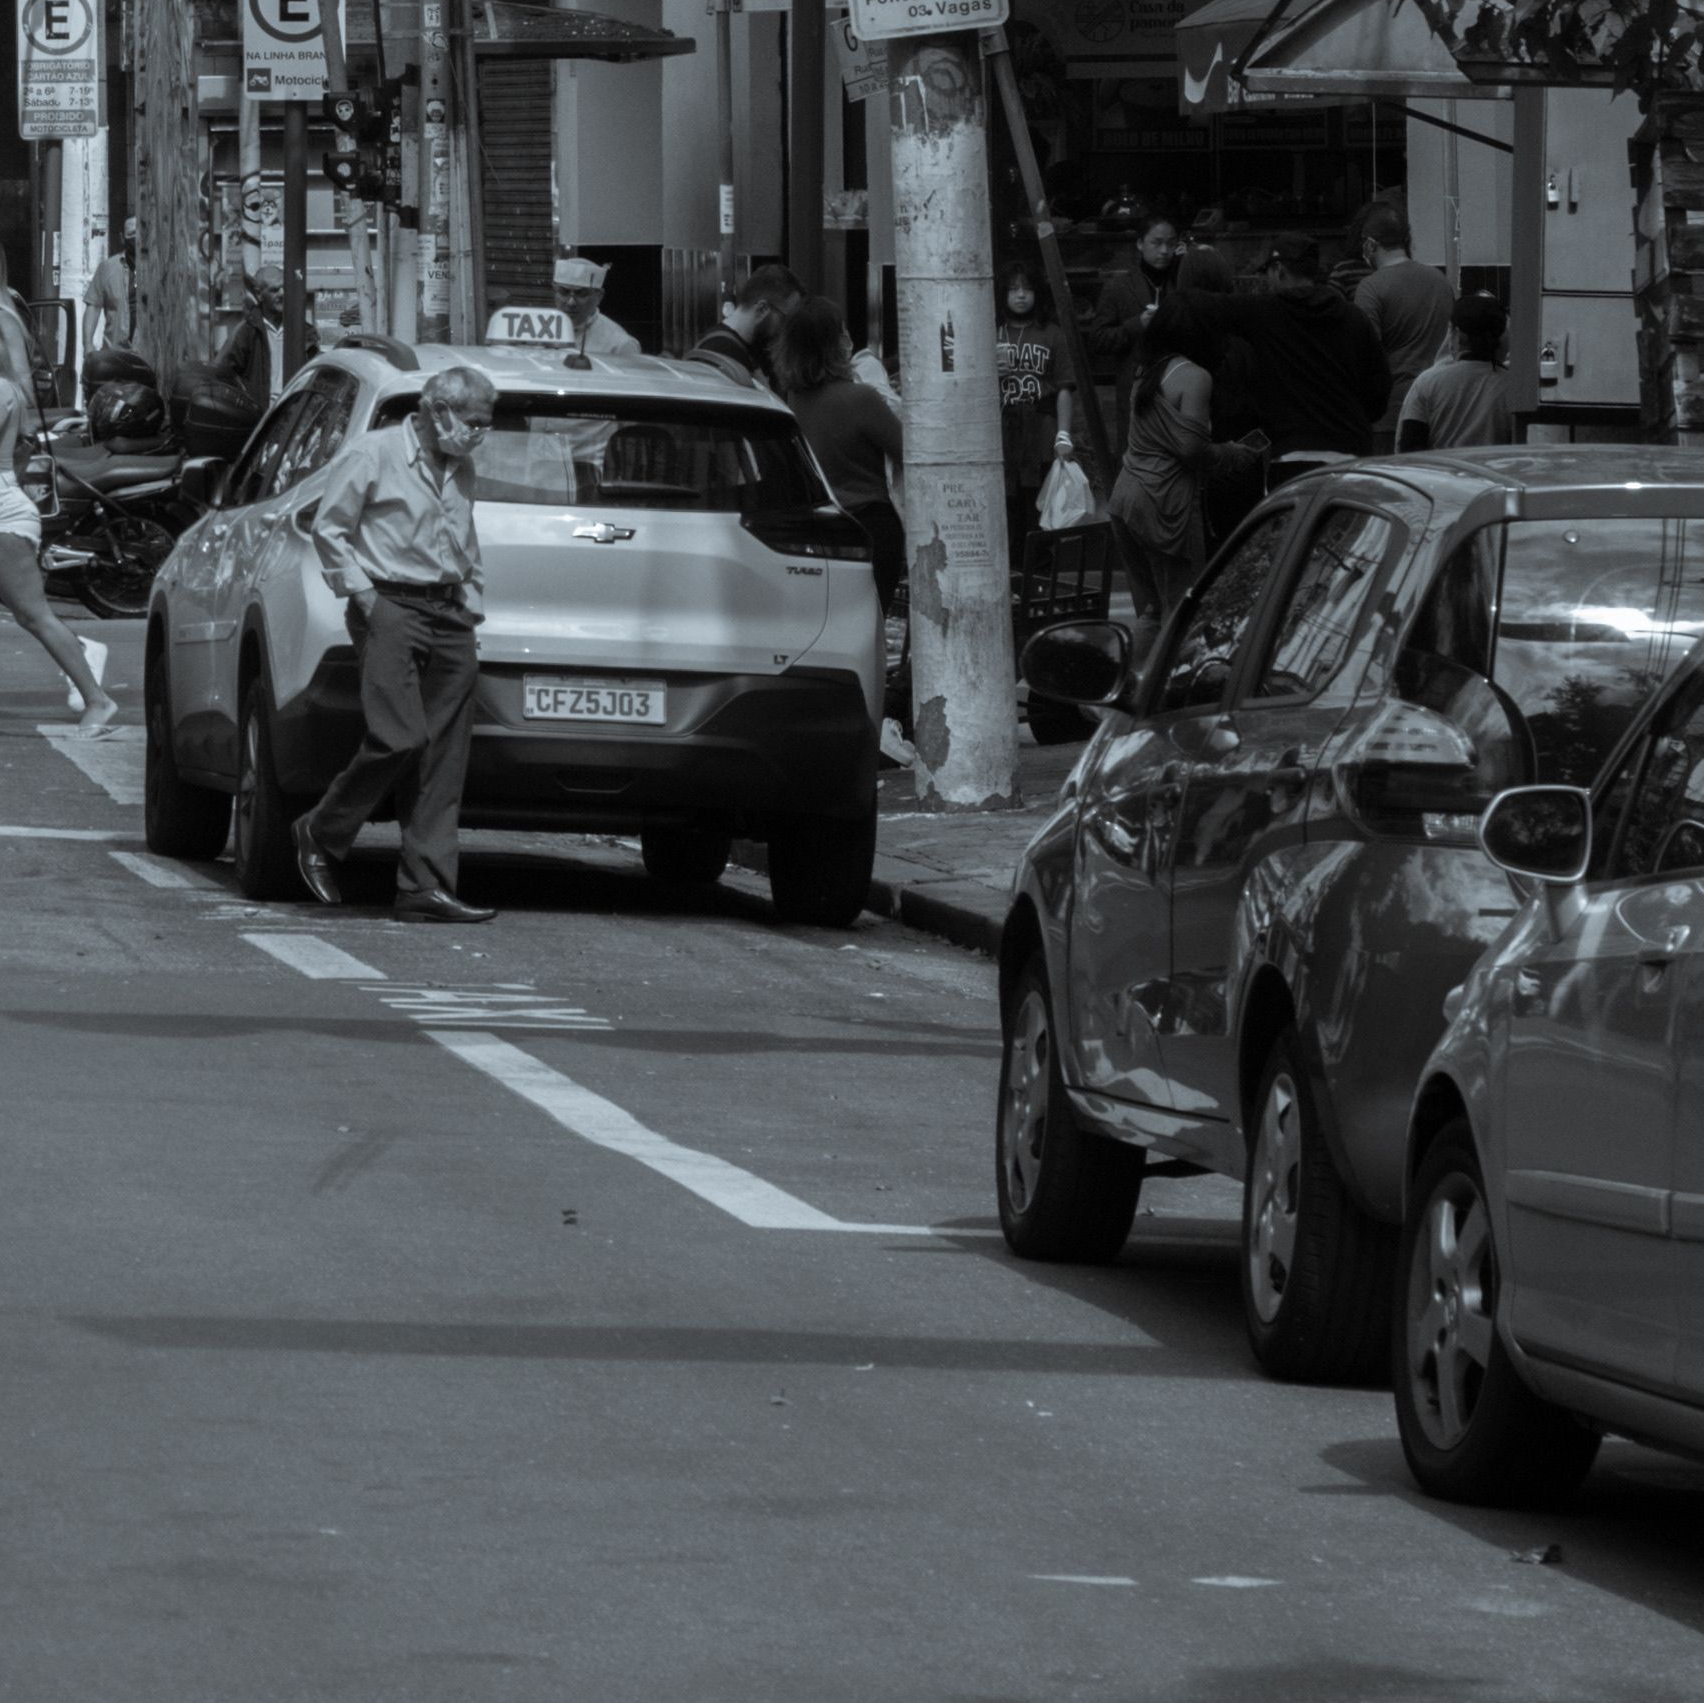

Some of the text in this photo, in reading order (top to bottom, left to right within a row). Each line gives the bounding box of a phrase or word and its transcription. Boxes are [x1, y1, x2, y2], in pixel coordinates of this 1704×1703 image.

[45, 0, 70, 40] E
[246, 51, 327, 61] NA LINHA BRAN
[33, 112, 84, 122] PROIBIDO
[30, 124, 88, 134] MOTOCICLETA
[501, 312, 564, 340] TAXI
[786, 567, 823, 577] TURBO
[774, 654, 790, 666] LT
[536, 687, 651, 718] CFZ5J03
